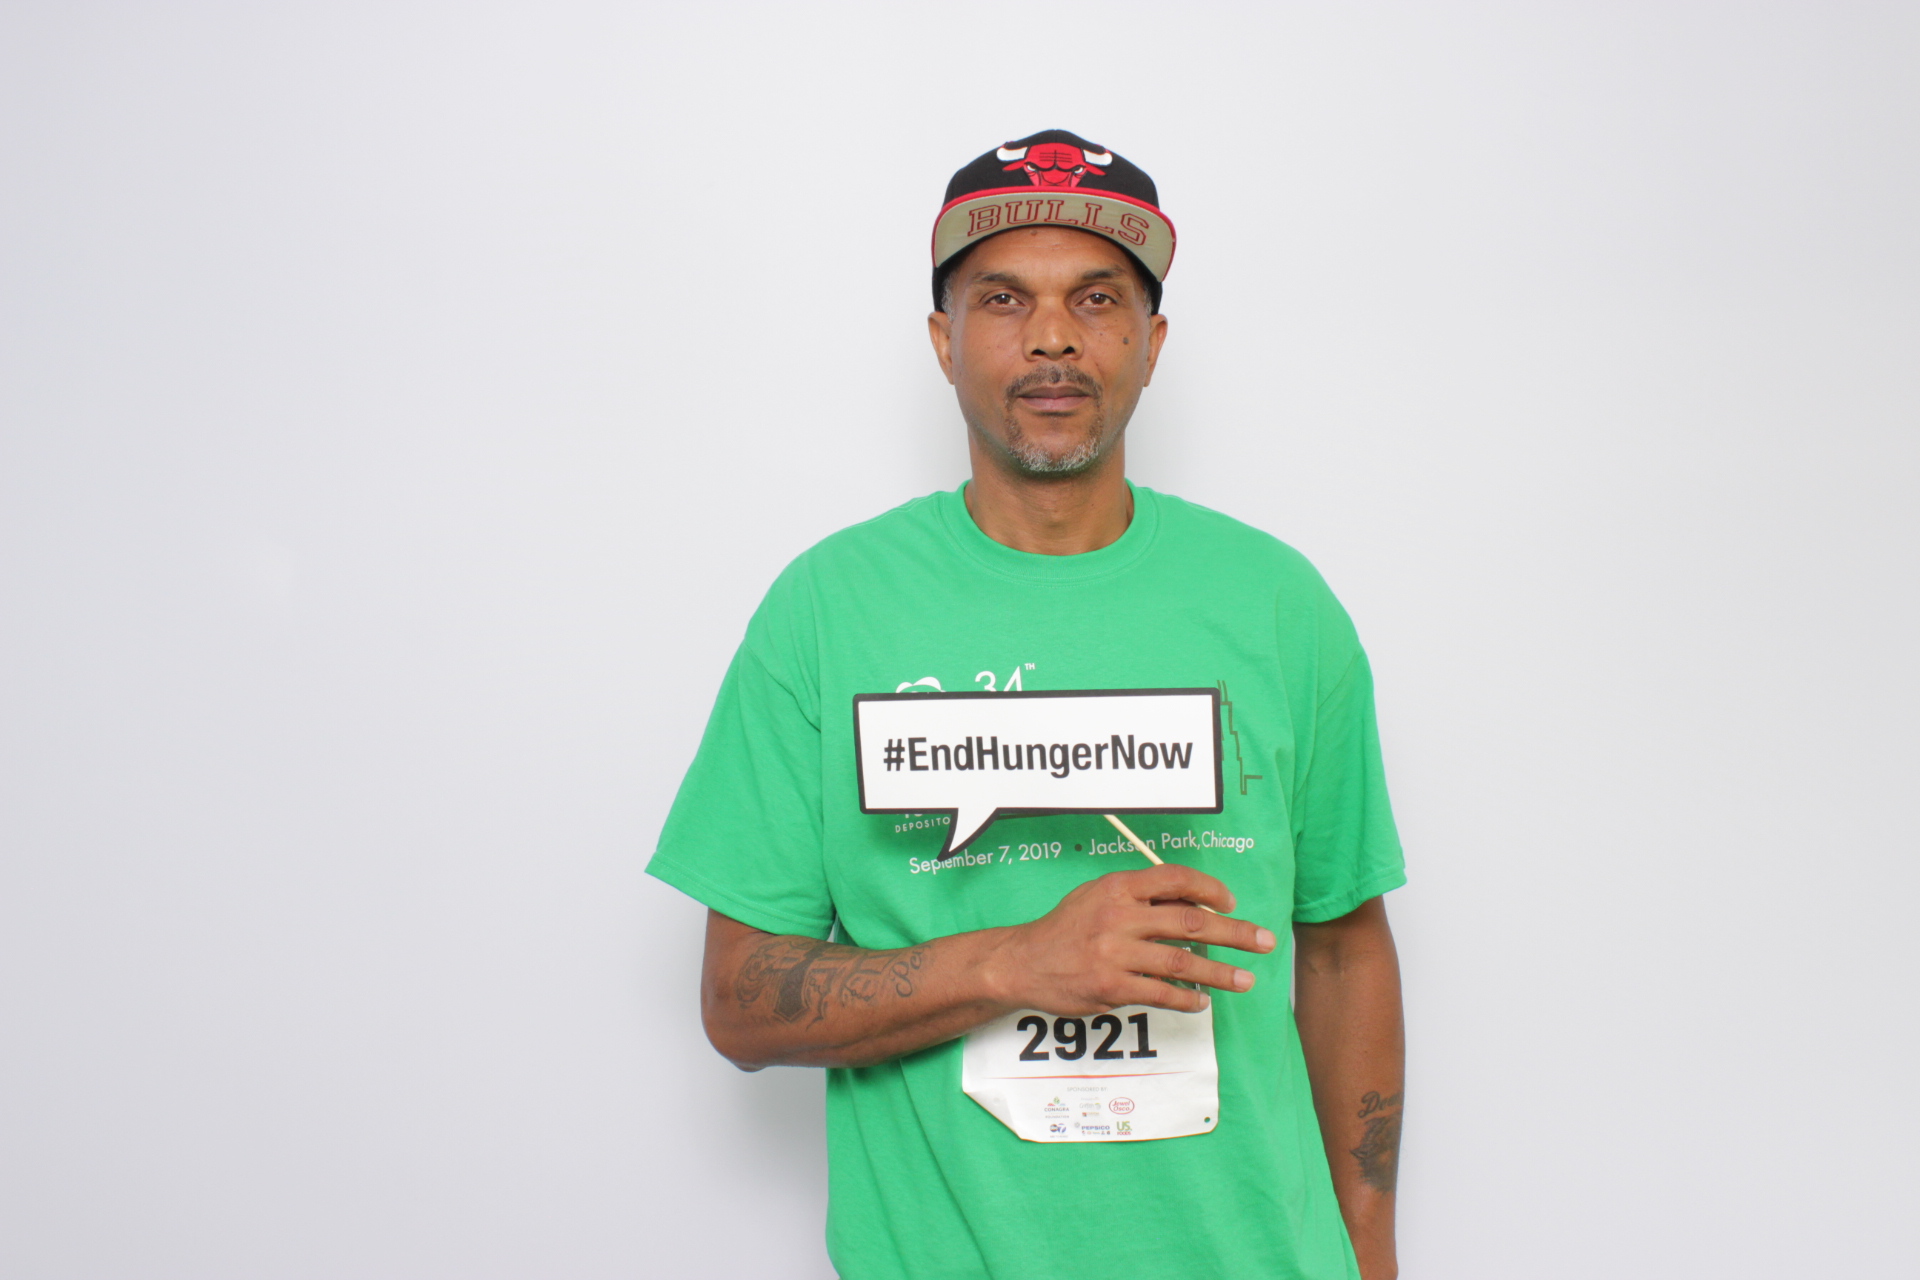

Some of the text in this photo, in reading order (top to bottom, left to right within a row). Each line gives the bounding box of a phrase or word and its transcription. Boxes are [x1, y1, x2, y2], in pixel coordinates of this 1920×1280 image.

[967, 200, 1149, 245] BULLS
[883, 735, 1193, 778] #EndHungerNow
[895, 816, 951, 833] DEPOSITO
[1019, 842, 1062, 861] 2019
[1017, 1012, 1158, 1061] 2921
